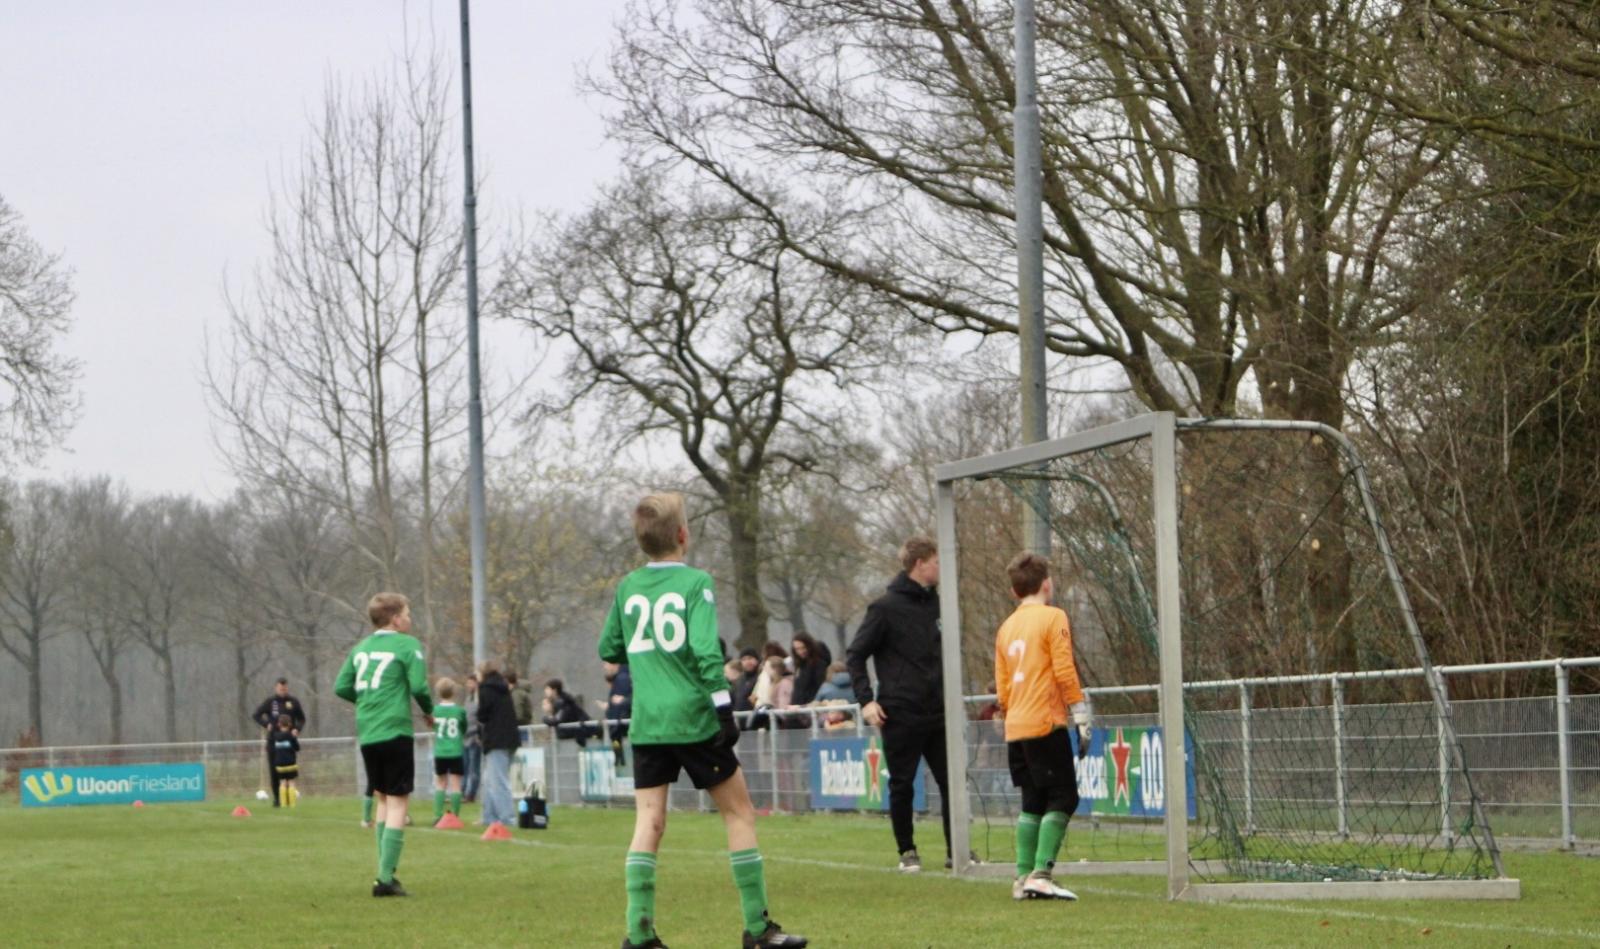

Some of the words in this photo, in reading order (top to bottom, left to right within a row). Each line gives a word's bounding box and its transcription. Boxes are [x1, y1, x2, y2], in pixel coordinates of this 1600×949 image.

[624, 592, 687, 654] 26
[353, 651, 395, 691] 27
[1007, 640, 1026, 683] 2
[434, 717, 459, 739] 78
[77, 774, 200, 795] WoonFriesland
[820, 749, 866, 796] Heineken
